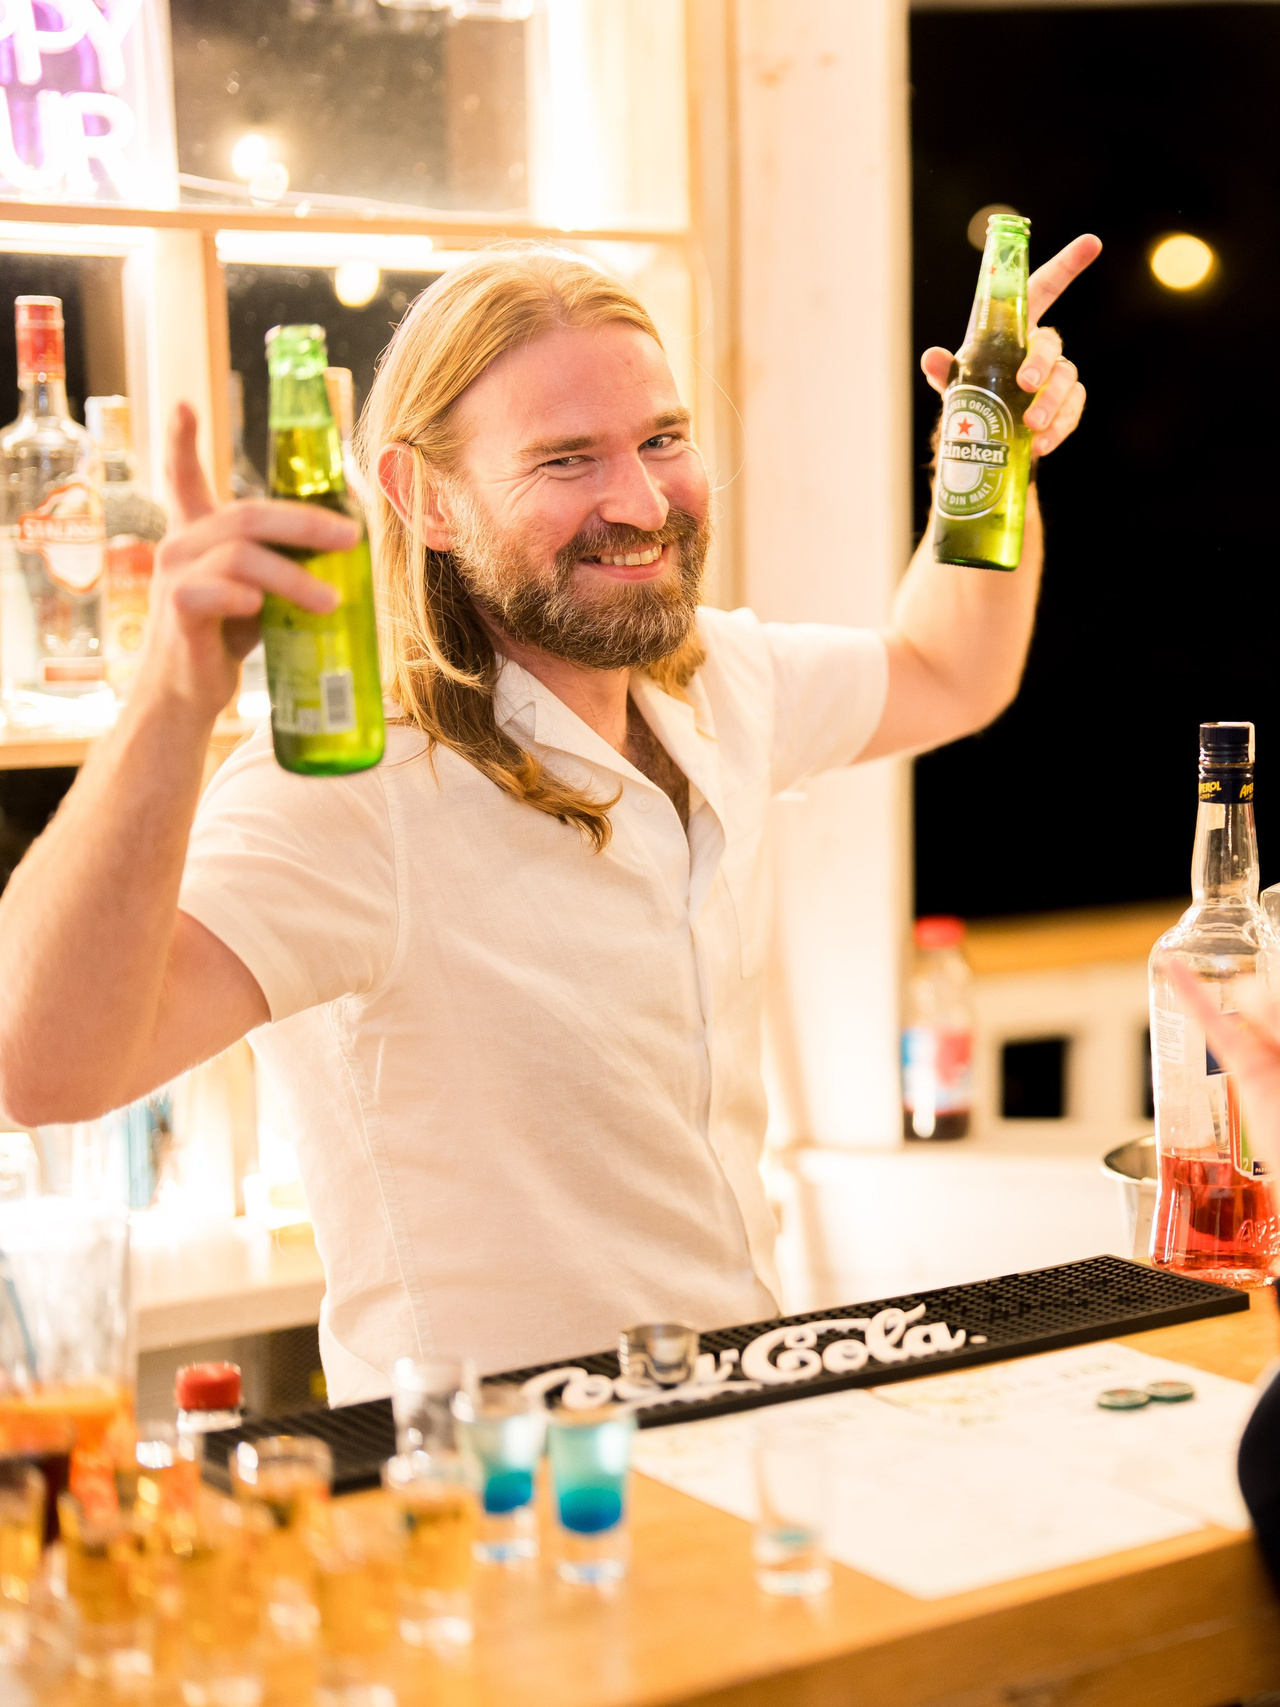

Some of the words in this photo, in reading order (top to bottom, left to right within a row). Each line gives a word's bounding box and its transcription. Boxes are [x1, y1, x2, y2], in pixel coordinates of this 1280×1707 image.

[969, 400, 1000, 434] ORIGINAL
[943, 441, 1005, 463] eineken
[949, 495, 967, 505] DIN
[969, 482, 994, 503] MALT
